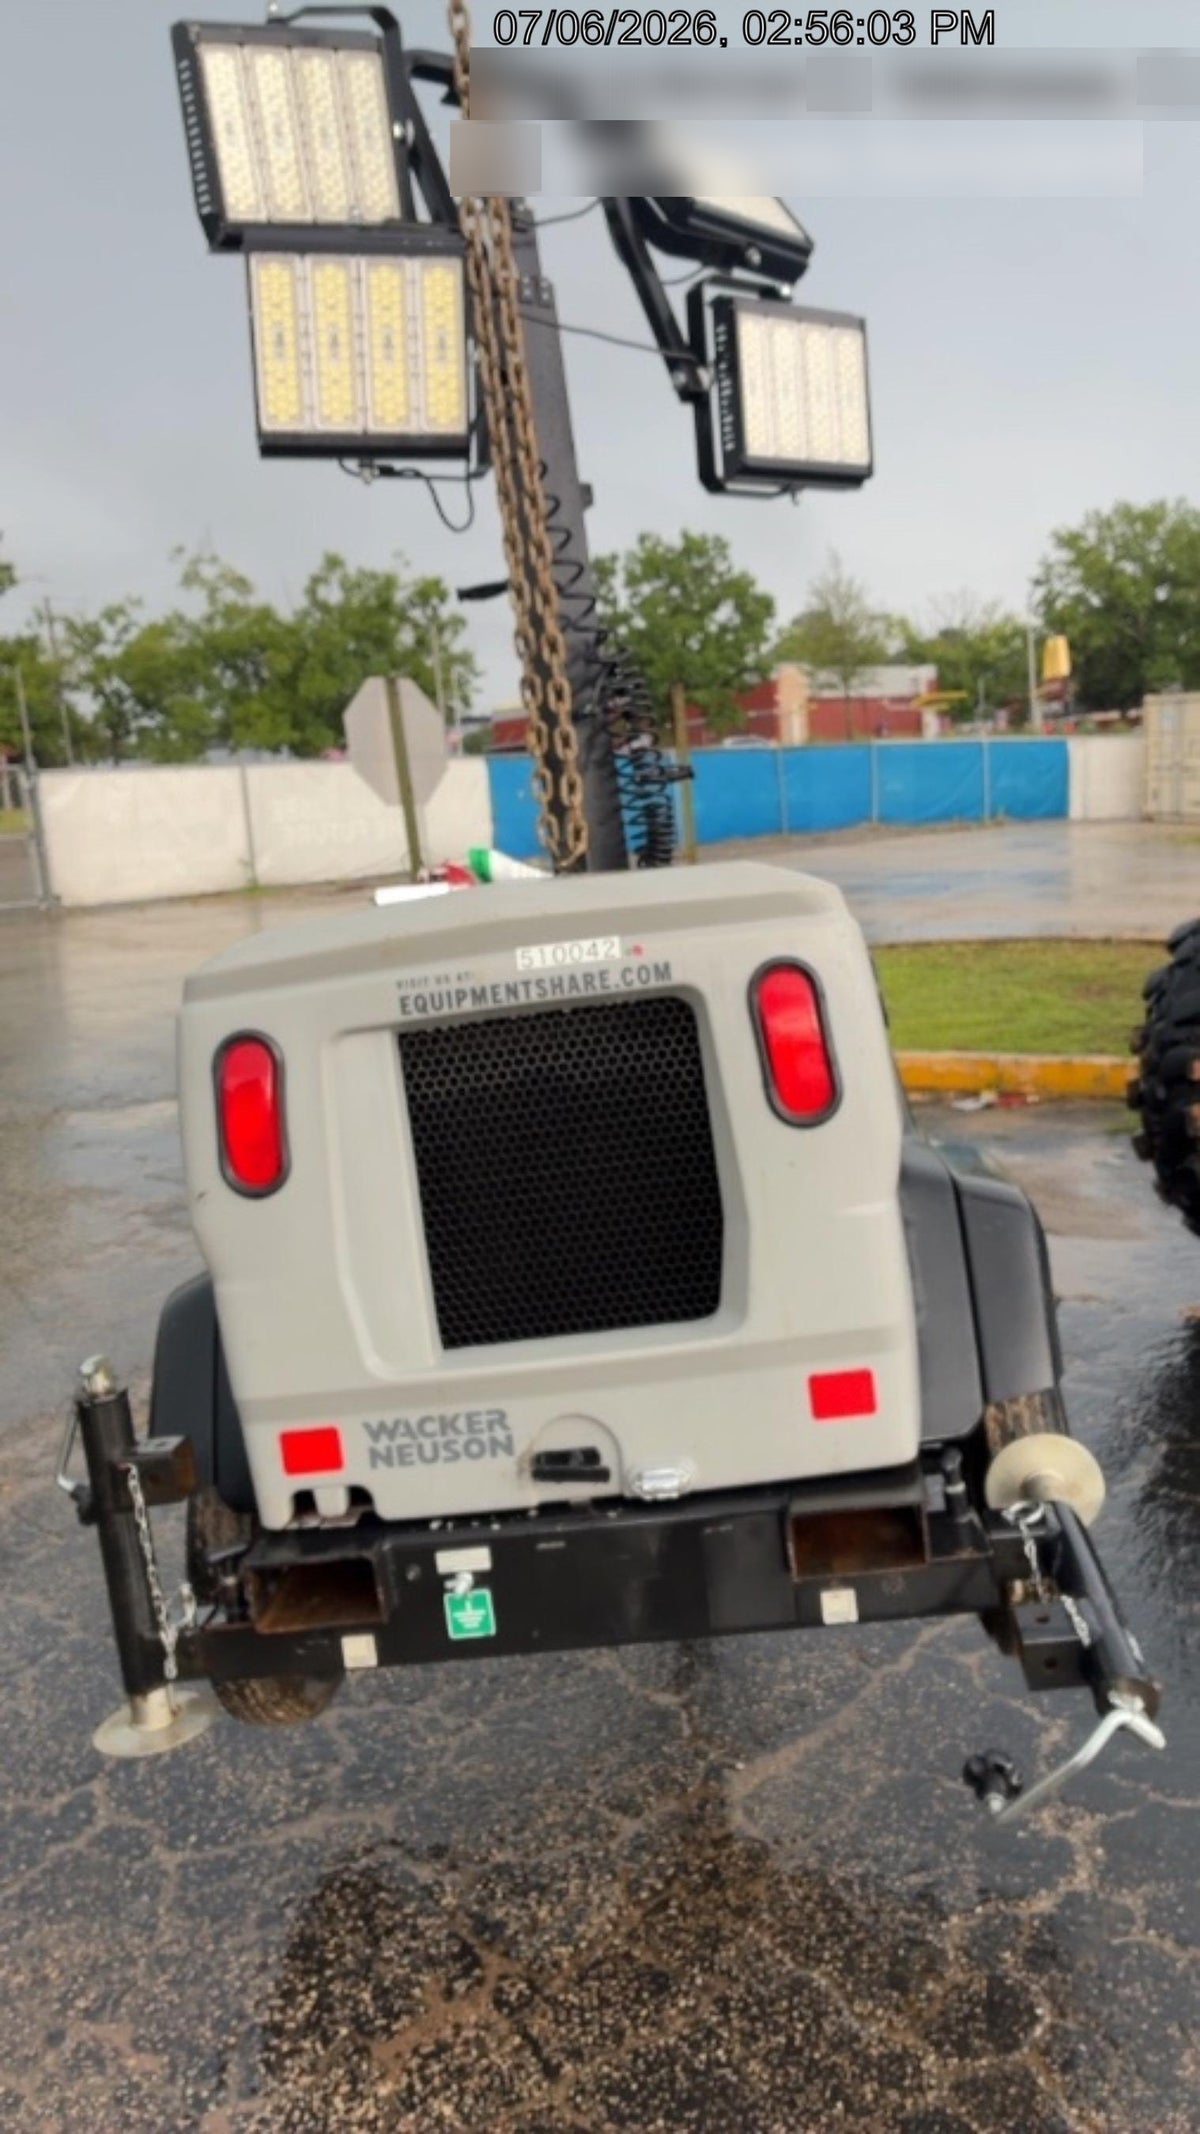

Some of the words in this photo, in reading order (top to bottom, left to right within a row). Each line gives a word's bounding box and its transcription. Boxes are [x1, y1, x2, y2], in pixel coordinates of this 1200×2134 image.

[520, 939, 618, 970] 510042
[399, 960, 673, 1017] EQUIPMENTSHARE.COM
[363, 1409, 511, 1442] WACKER
[369, 1435, 514, 1468] NEUSON
